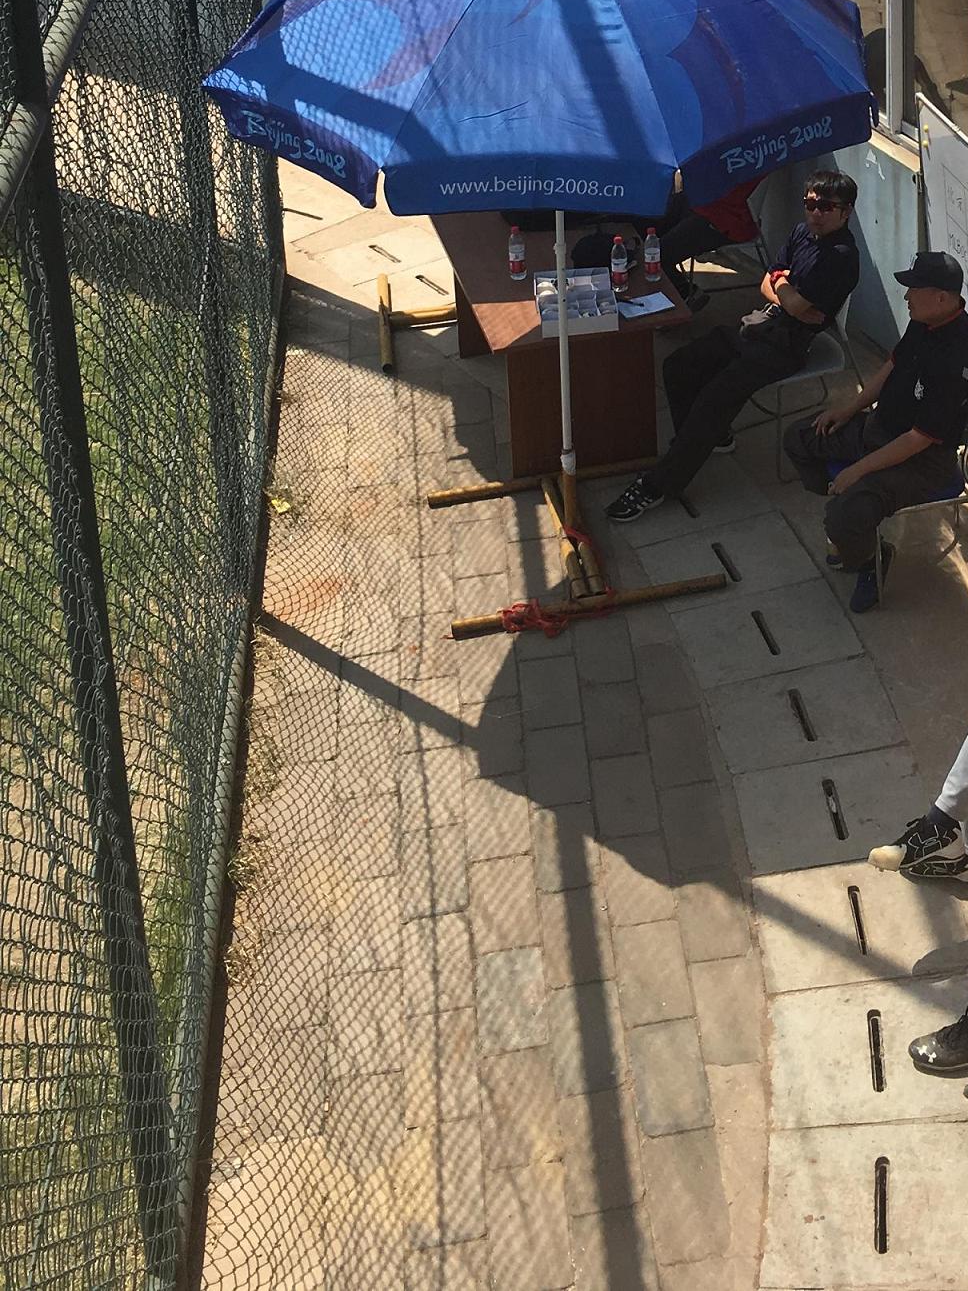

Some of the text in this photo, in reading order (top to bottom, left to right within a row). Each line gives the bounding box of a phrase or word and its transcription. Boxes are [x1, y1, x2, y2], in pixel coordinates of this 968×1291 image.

[241, 110, 346, 179] Beijing 2008
[720, 115, 833, 174] Beijing 2008
[440, 176, 625, 197] www.beijing2008.cn
